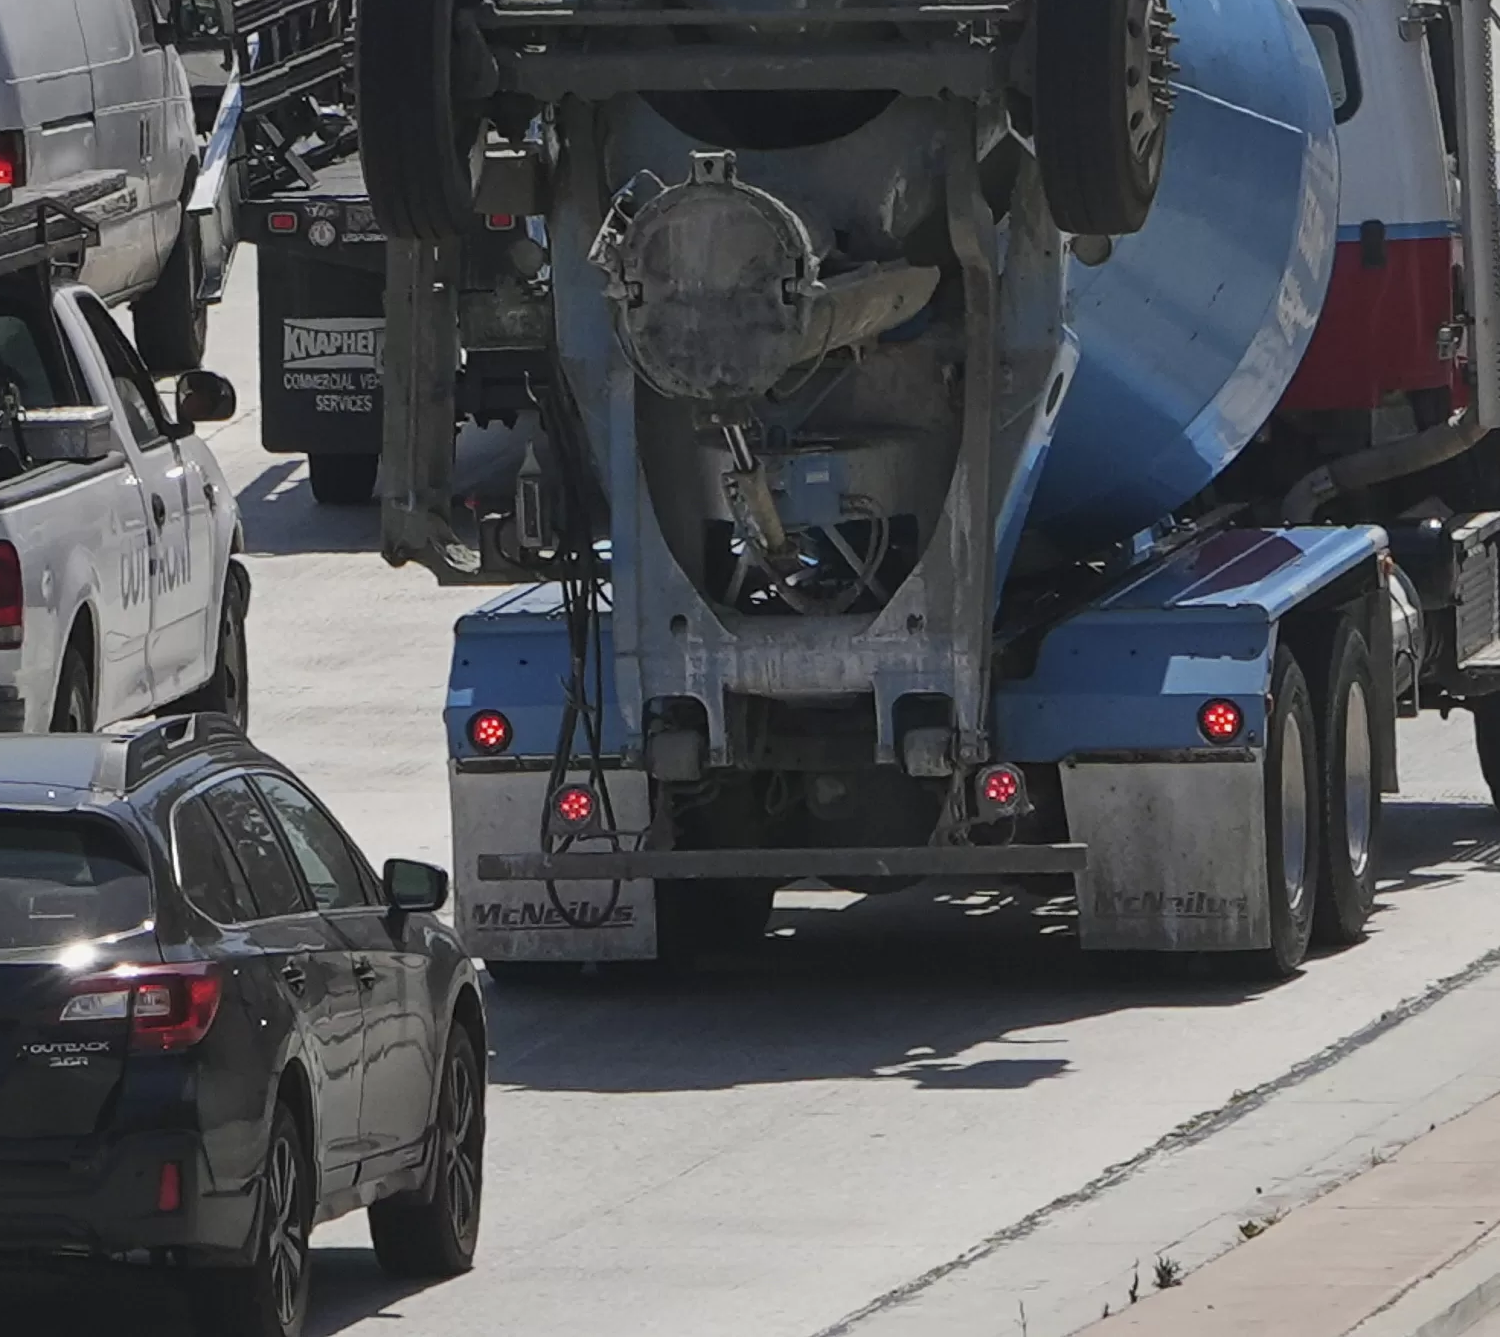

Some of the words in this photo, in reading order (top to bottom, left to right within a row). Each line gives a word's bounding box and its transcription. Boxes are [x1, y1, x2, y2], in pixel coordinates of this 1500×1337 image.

[283, 372, 357, 391] COMMERCIAL
[315, 393, 374, 413] SERVICES
[472, 901, 636, 926] McNeilus
[29, 1041, 112, 1055] OUTBACK
